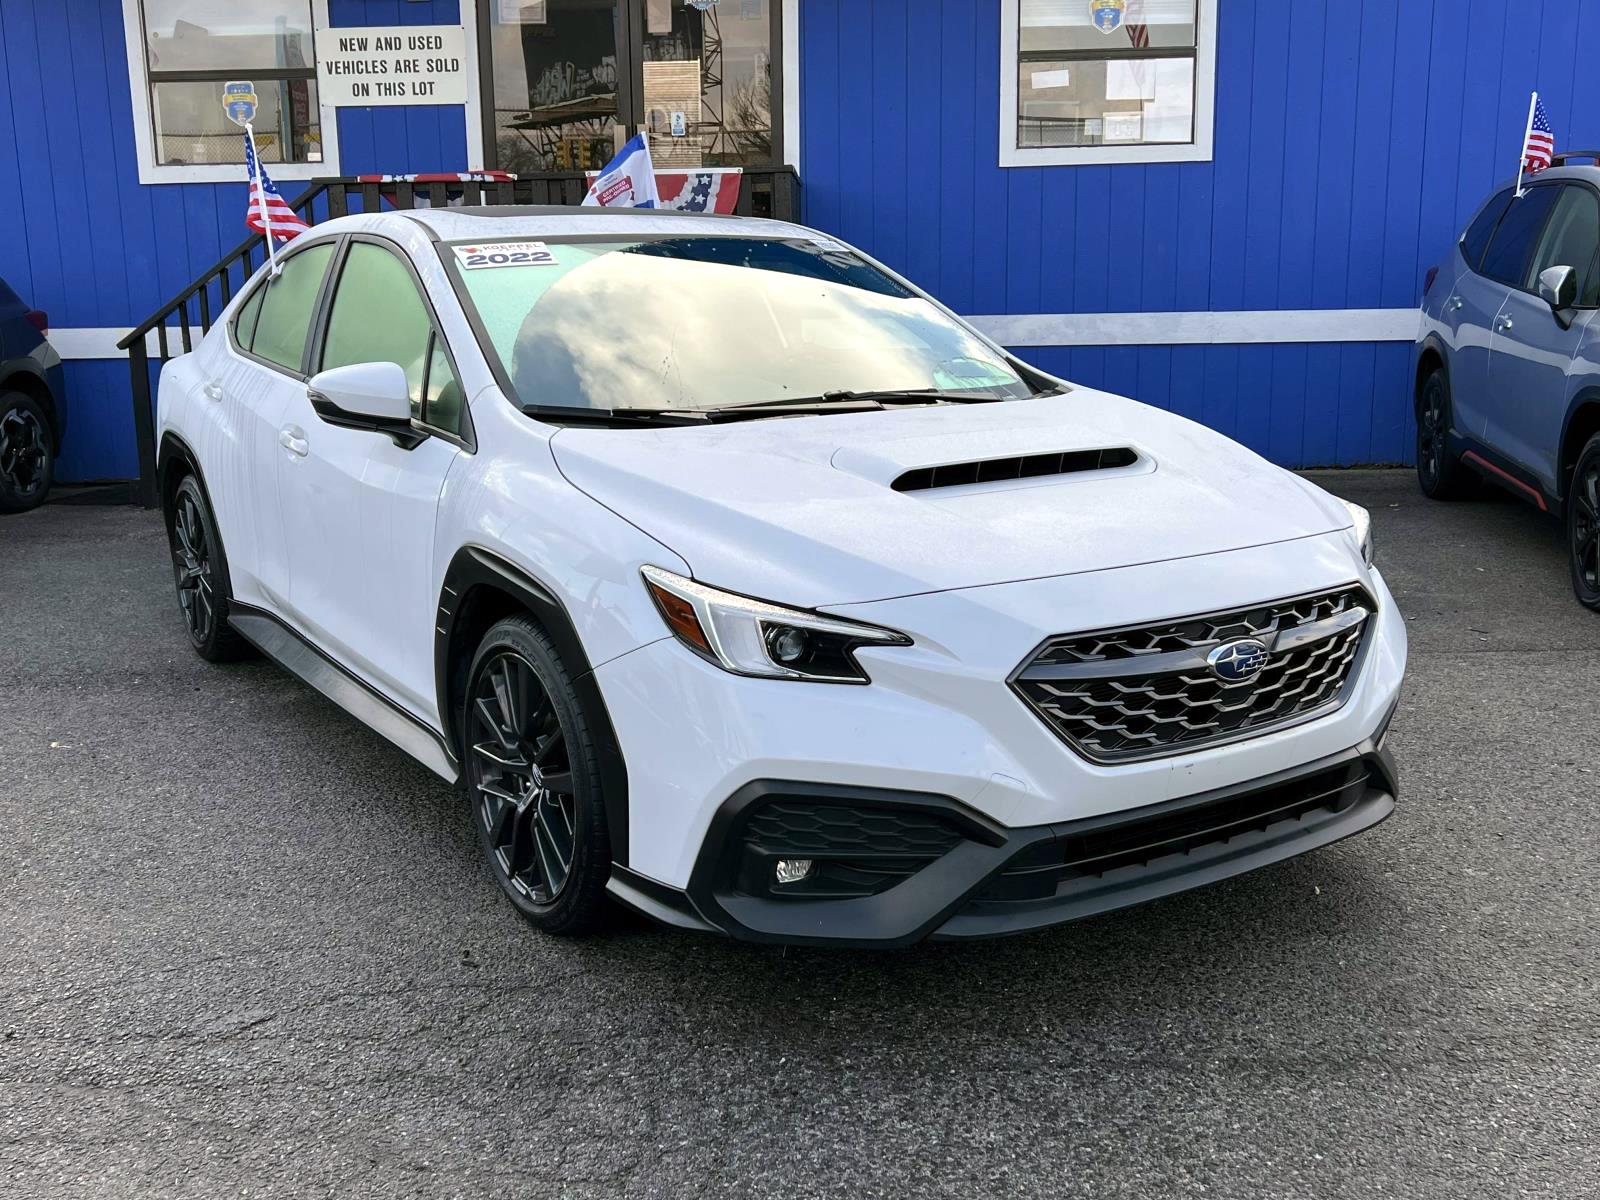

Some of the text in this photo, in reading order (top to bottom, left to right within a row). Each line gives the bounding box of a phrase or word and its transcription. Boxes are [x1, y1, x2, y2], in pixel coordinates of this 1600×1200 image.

[340, 35, 443, 52] NEW AND USED
[326, 58, 460, 75] VEHICLES ARE SOLD
[352, 81, 435, 97] ON THIS LOT
[602, 180, 626, 198] CERTIFIED
[482, 243, 542, 251] KOEPPEL
[466, 251, 552, 266] 2022
